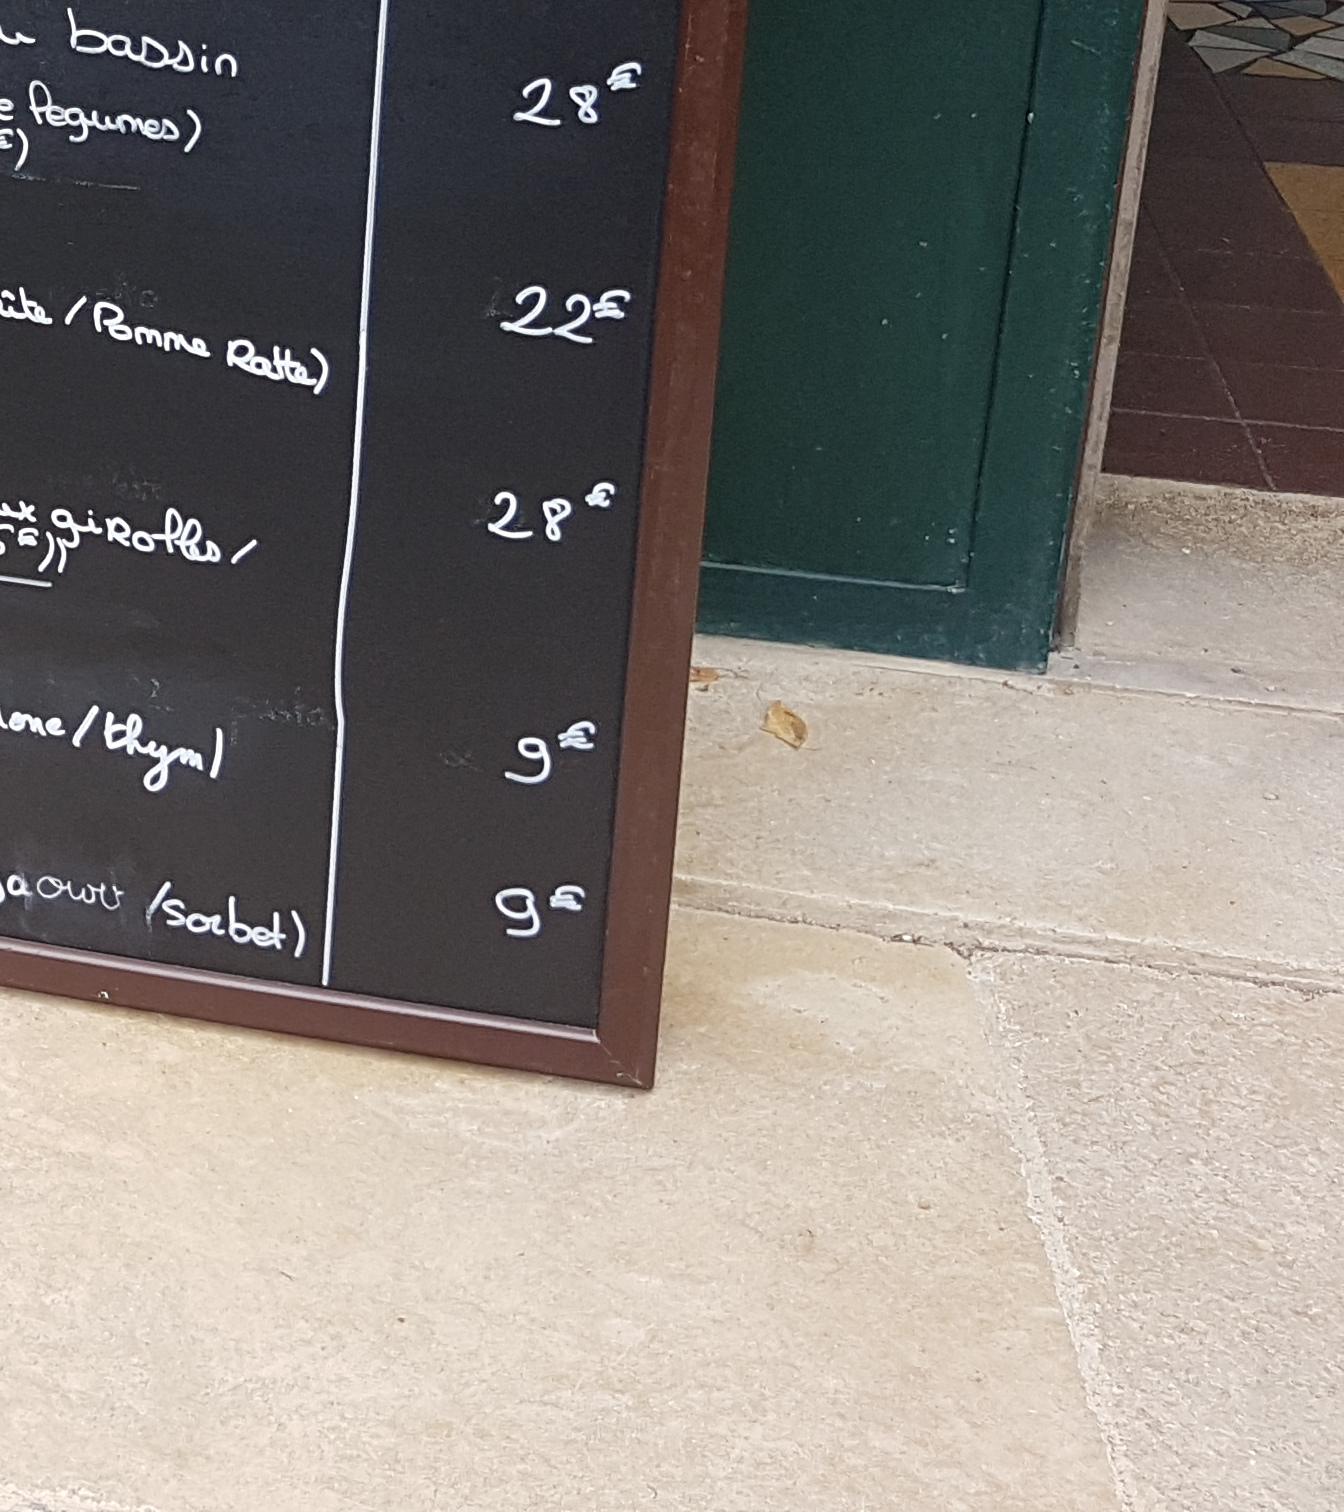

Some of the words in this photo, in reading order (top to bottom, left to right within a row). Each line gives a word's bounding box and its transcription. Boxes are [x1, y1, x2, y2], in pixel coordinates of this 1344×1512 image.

[66, 6, 238, 78] bassin
[512, 61, 642, 127] 28€
[499, 285, 632, 344] 22€
[487, 481, 616, 542] 28€
[504, 720, 597, 785] 9€
[494, 884, 586, 938] 9€
